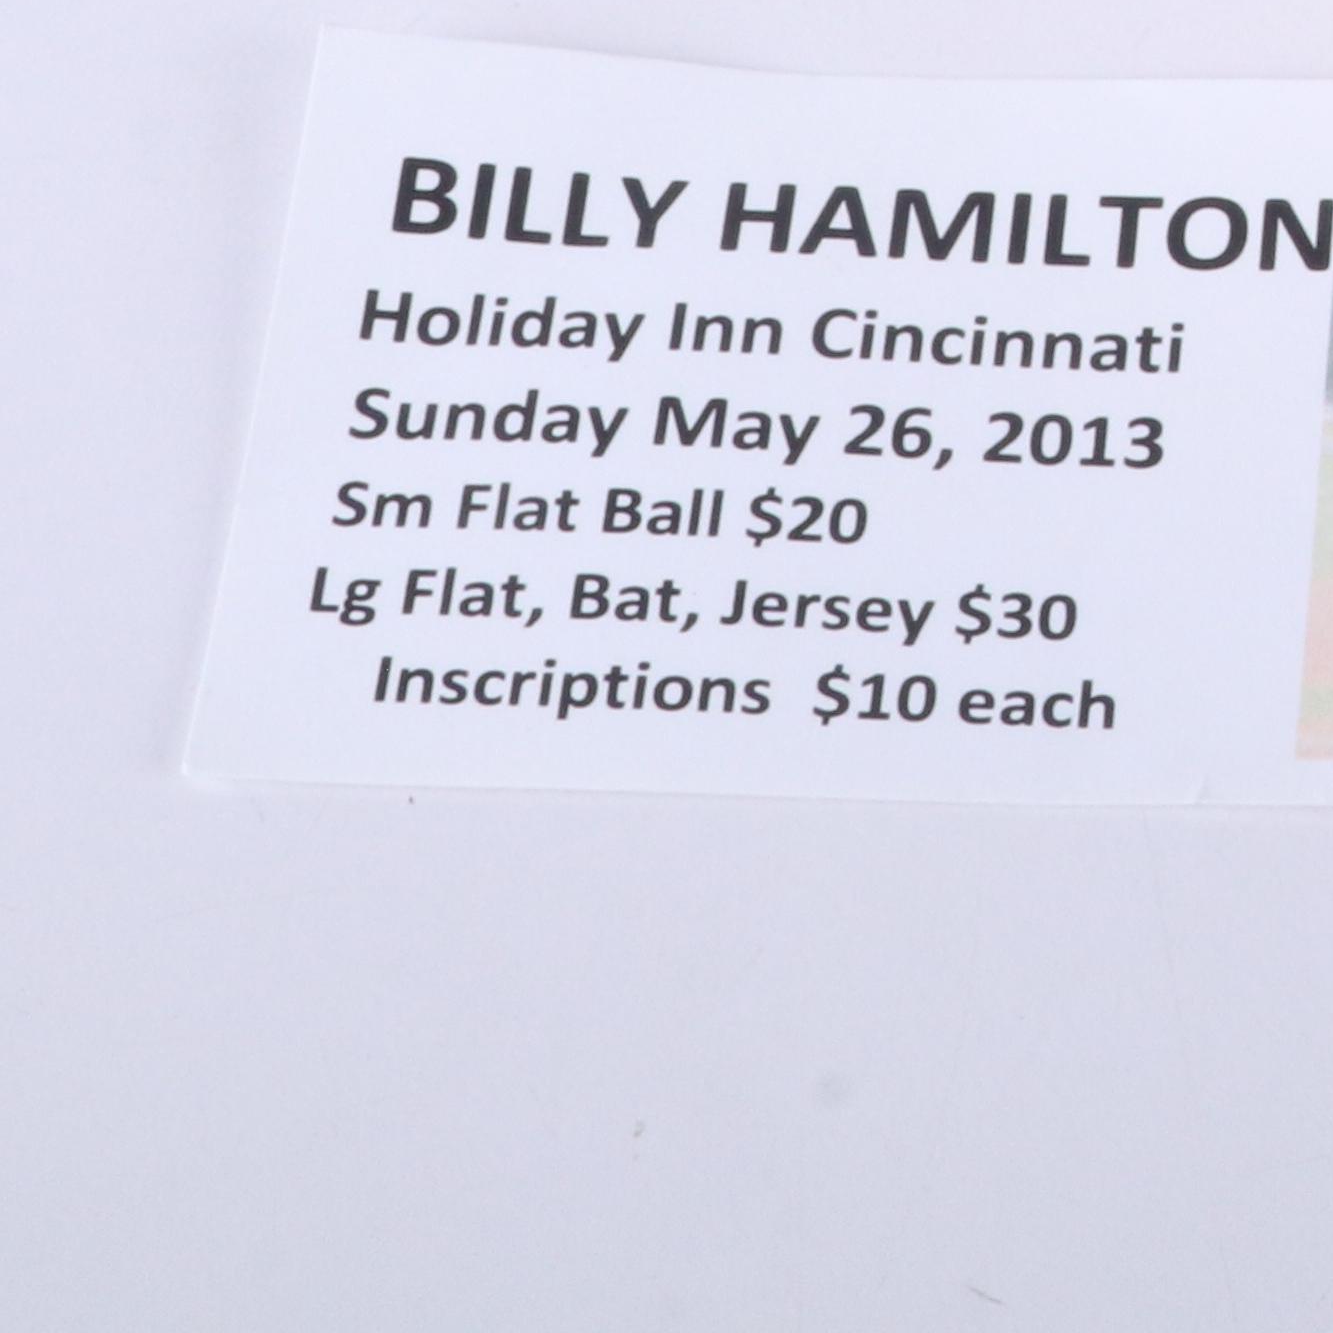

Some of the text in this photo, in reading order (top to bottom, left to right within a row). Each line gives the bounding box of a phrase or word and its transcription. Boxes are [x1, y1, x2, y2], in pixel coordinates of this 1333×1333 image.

[392, 156, 689, 248] BILLY
[359, 289, 1185, 373] Holiday Inn Cincinnati
[349, 389, 1164, 470] Sunday May 26, 2013
[332, 481, 868, 547] Sm Flat Ball $20
[309, 566, 1077, 646] Lg Flat, Bat, Jersey $30
[374, 656, 1117, 729] Inscriptions $10 each
